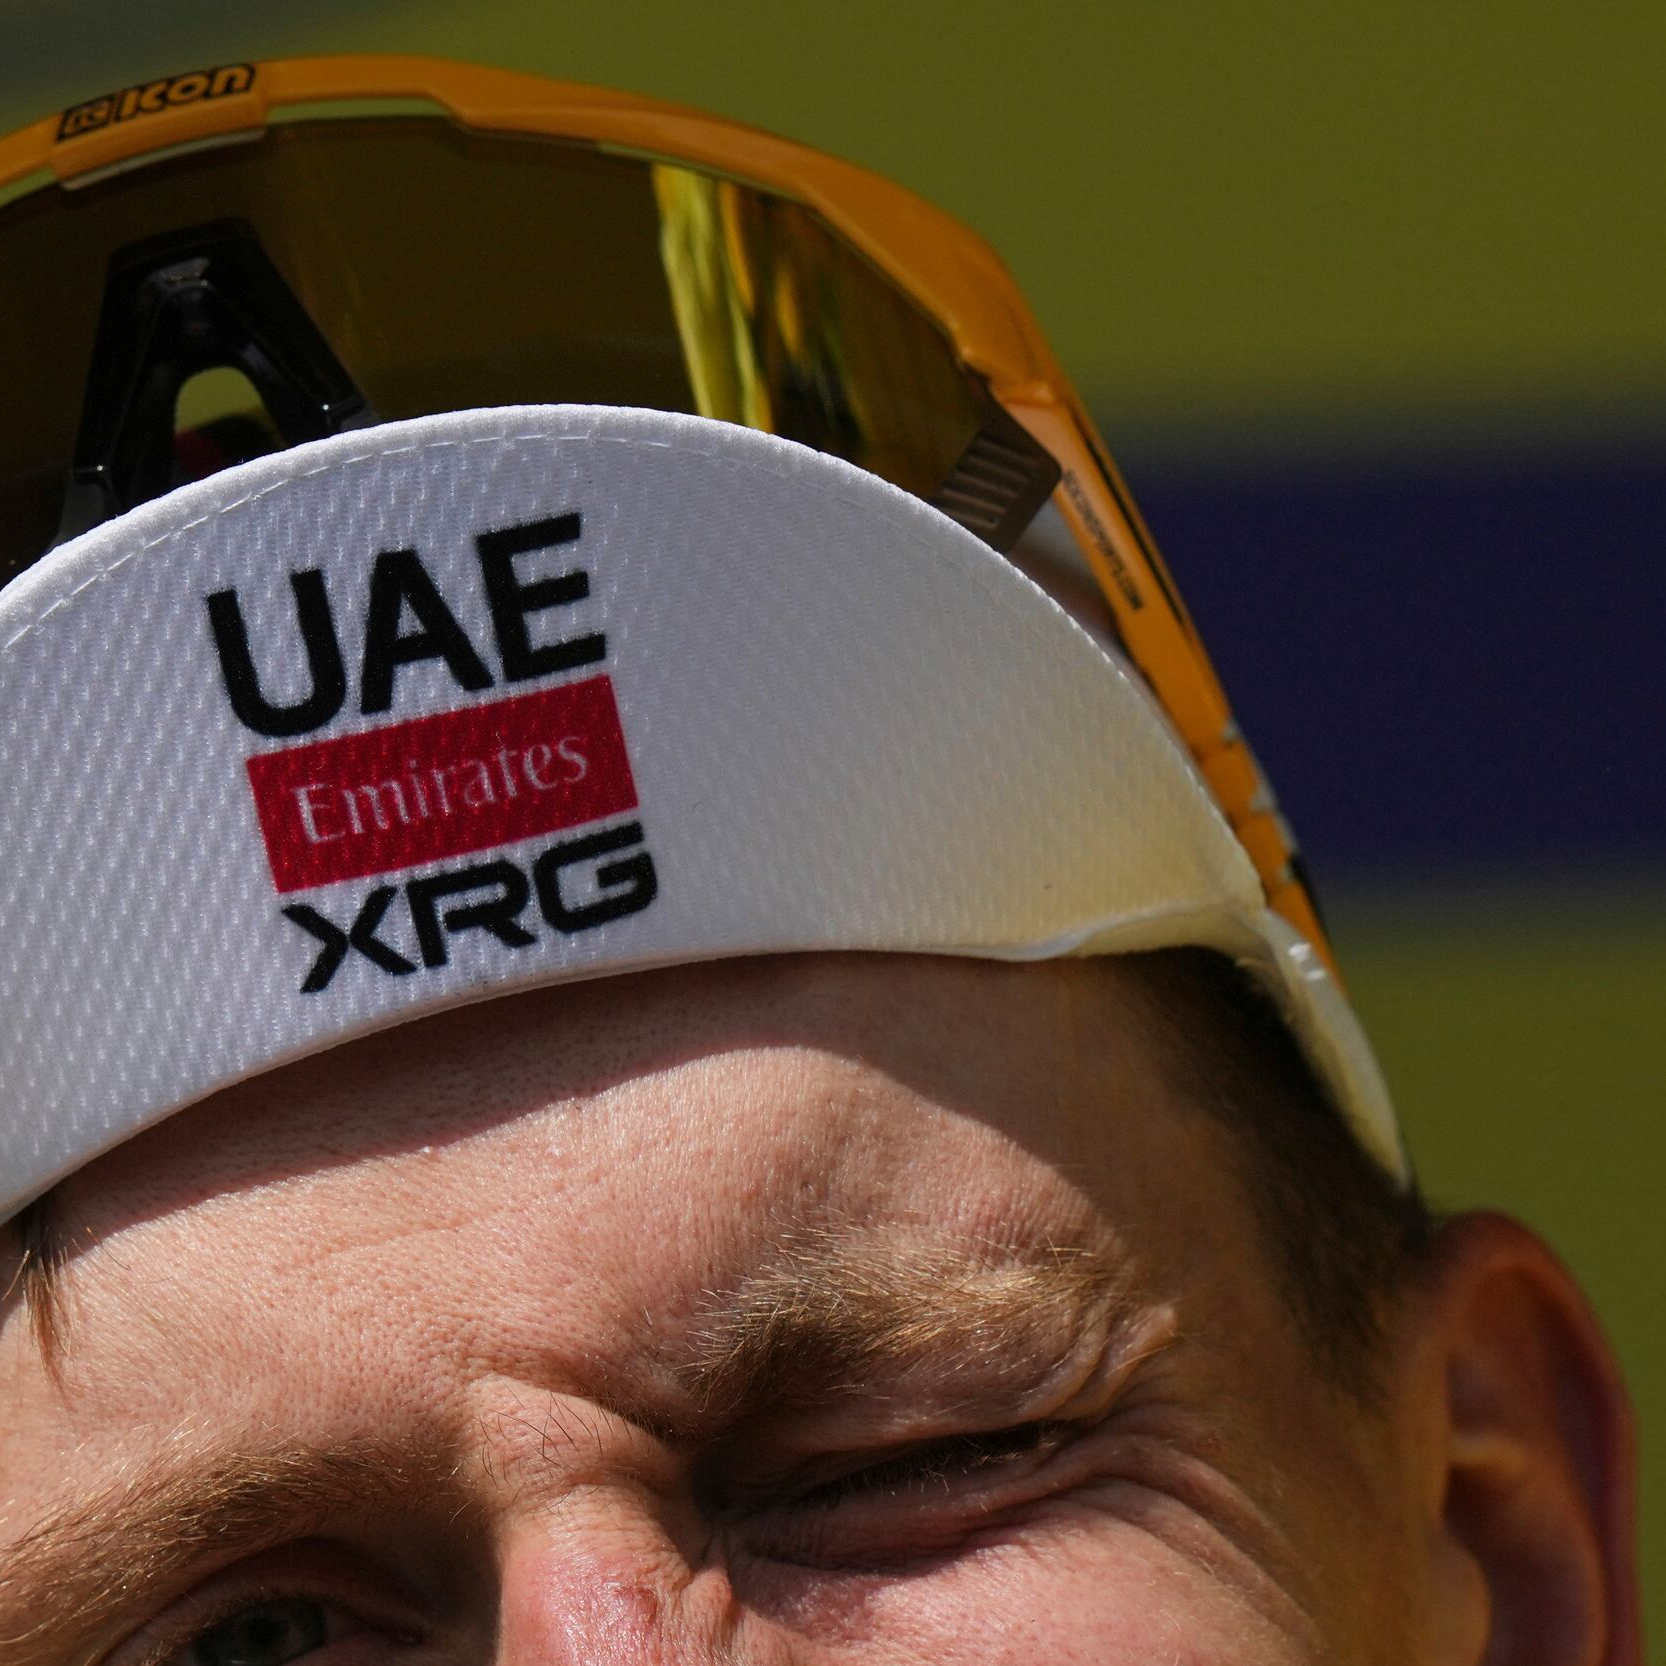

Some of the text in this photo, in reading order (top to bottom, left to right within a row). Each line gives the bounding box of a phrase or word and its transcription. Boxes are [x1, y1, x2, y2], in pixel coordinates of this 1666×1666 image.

[207, 512, 606, 737] UAE
[290, 734, 589, 845] Emirates
[282, 822, 657, 994] XRG
